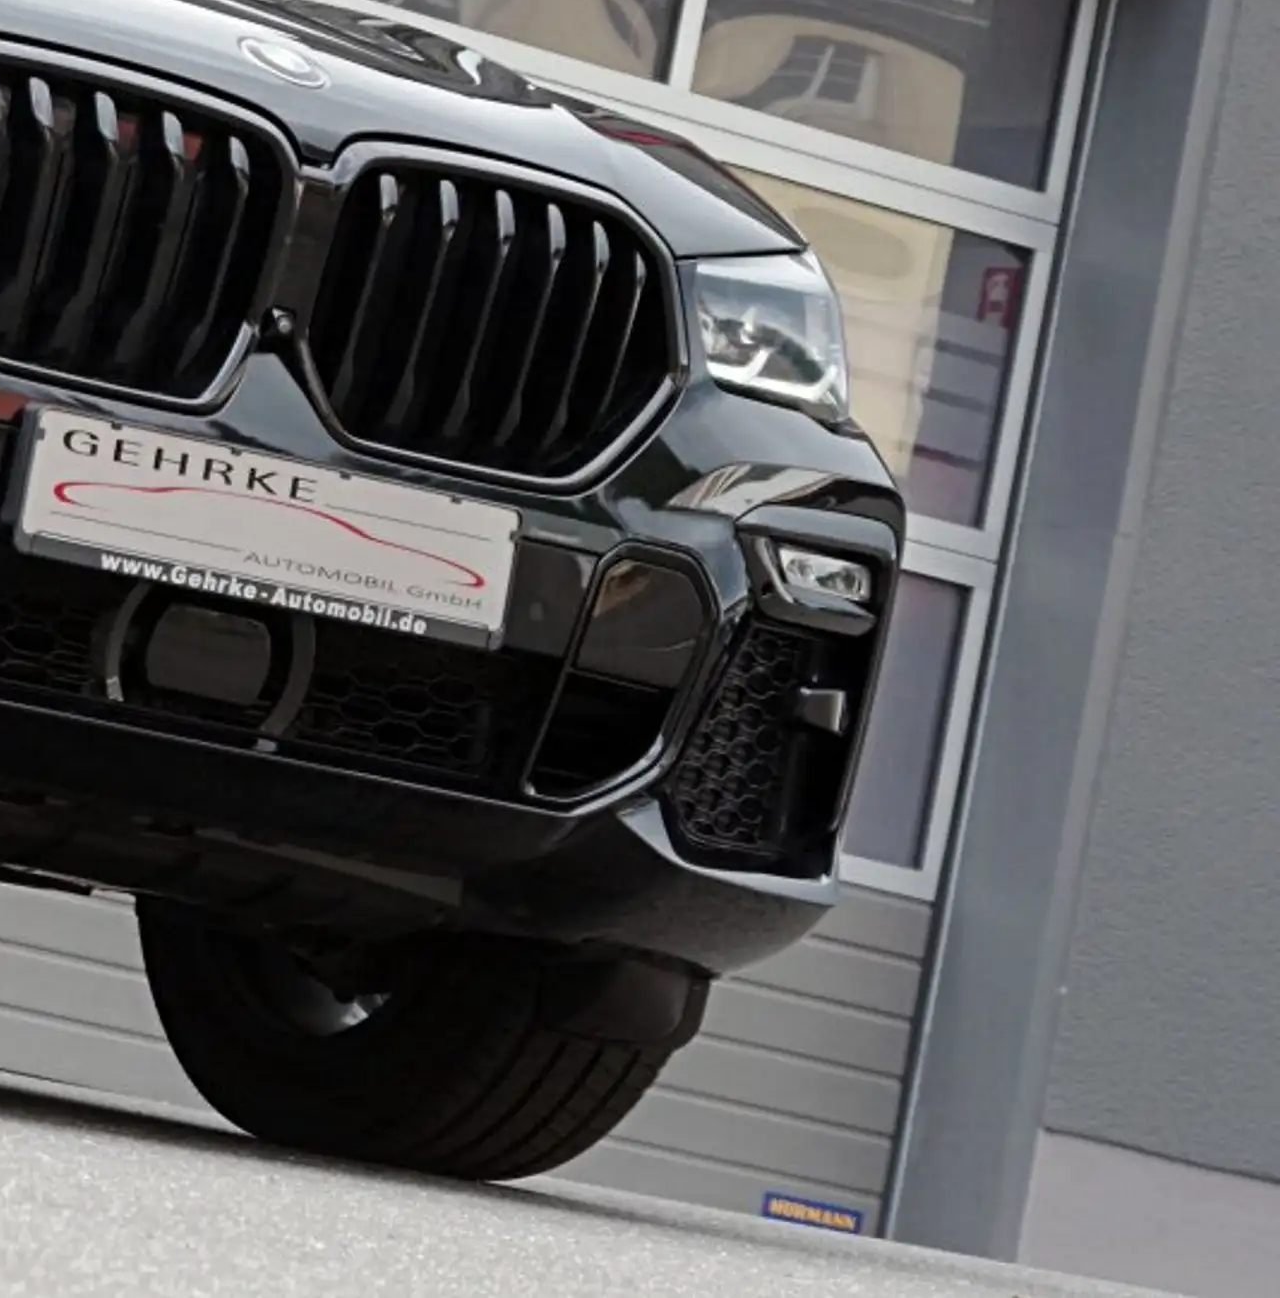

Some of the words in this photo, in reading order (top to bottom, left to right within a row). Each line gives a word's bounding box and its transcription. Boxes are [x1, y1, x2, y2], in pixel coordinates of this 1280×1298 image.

[62, 428, 319, 502] GEHRKE
[243, 551, 398, 593] AUTOMOBIL
[406, 585, 483, 610] GmbH
